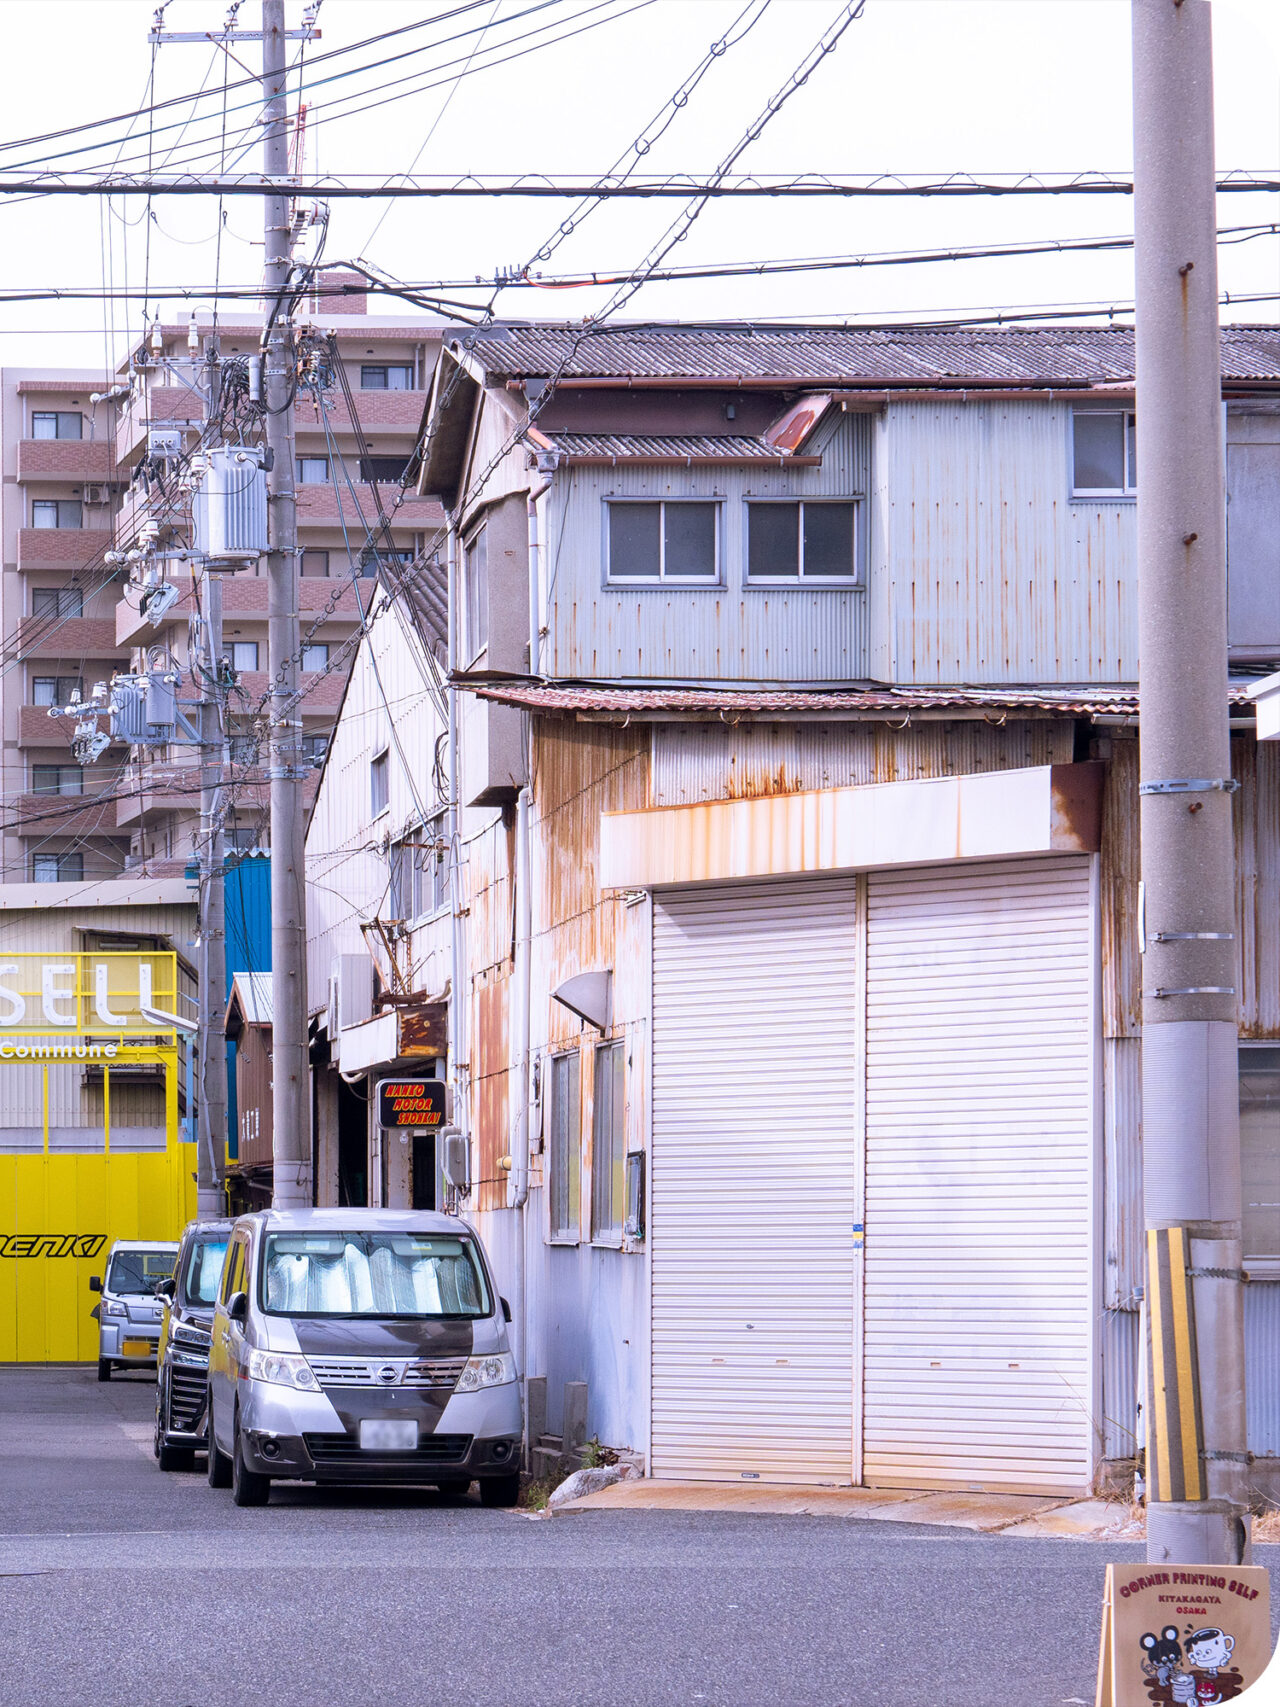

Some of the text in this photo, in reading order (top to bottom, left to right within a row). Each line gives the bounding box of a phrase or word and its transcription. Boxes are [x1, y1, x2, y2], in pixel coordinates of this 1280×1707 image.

[384, 1084, 425, 1098] NANKO
[392, 1097, 433, 1111] MOTOR
[1120, 1572, 1259, 1600] CORNER PRINTING SELF
[1176, 1606, 1207, 1615] OSAKA
